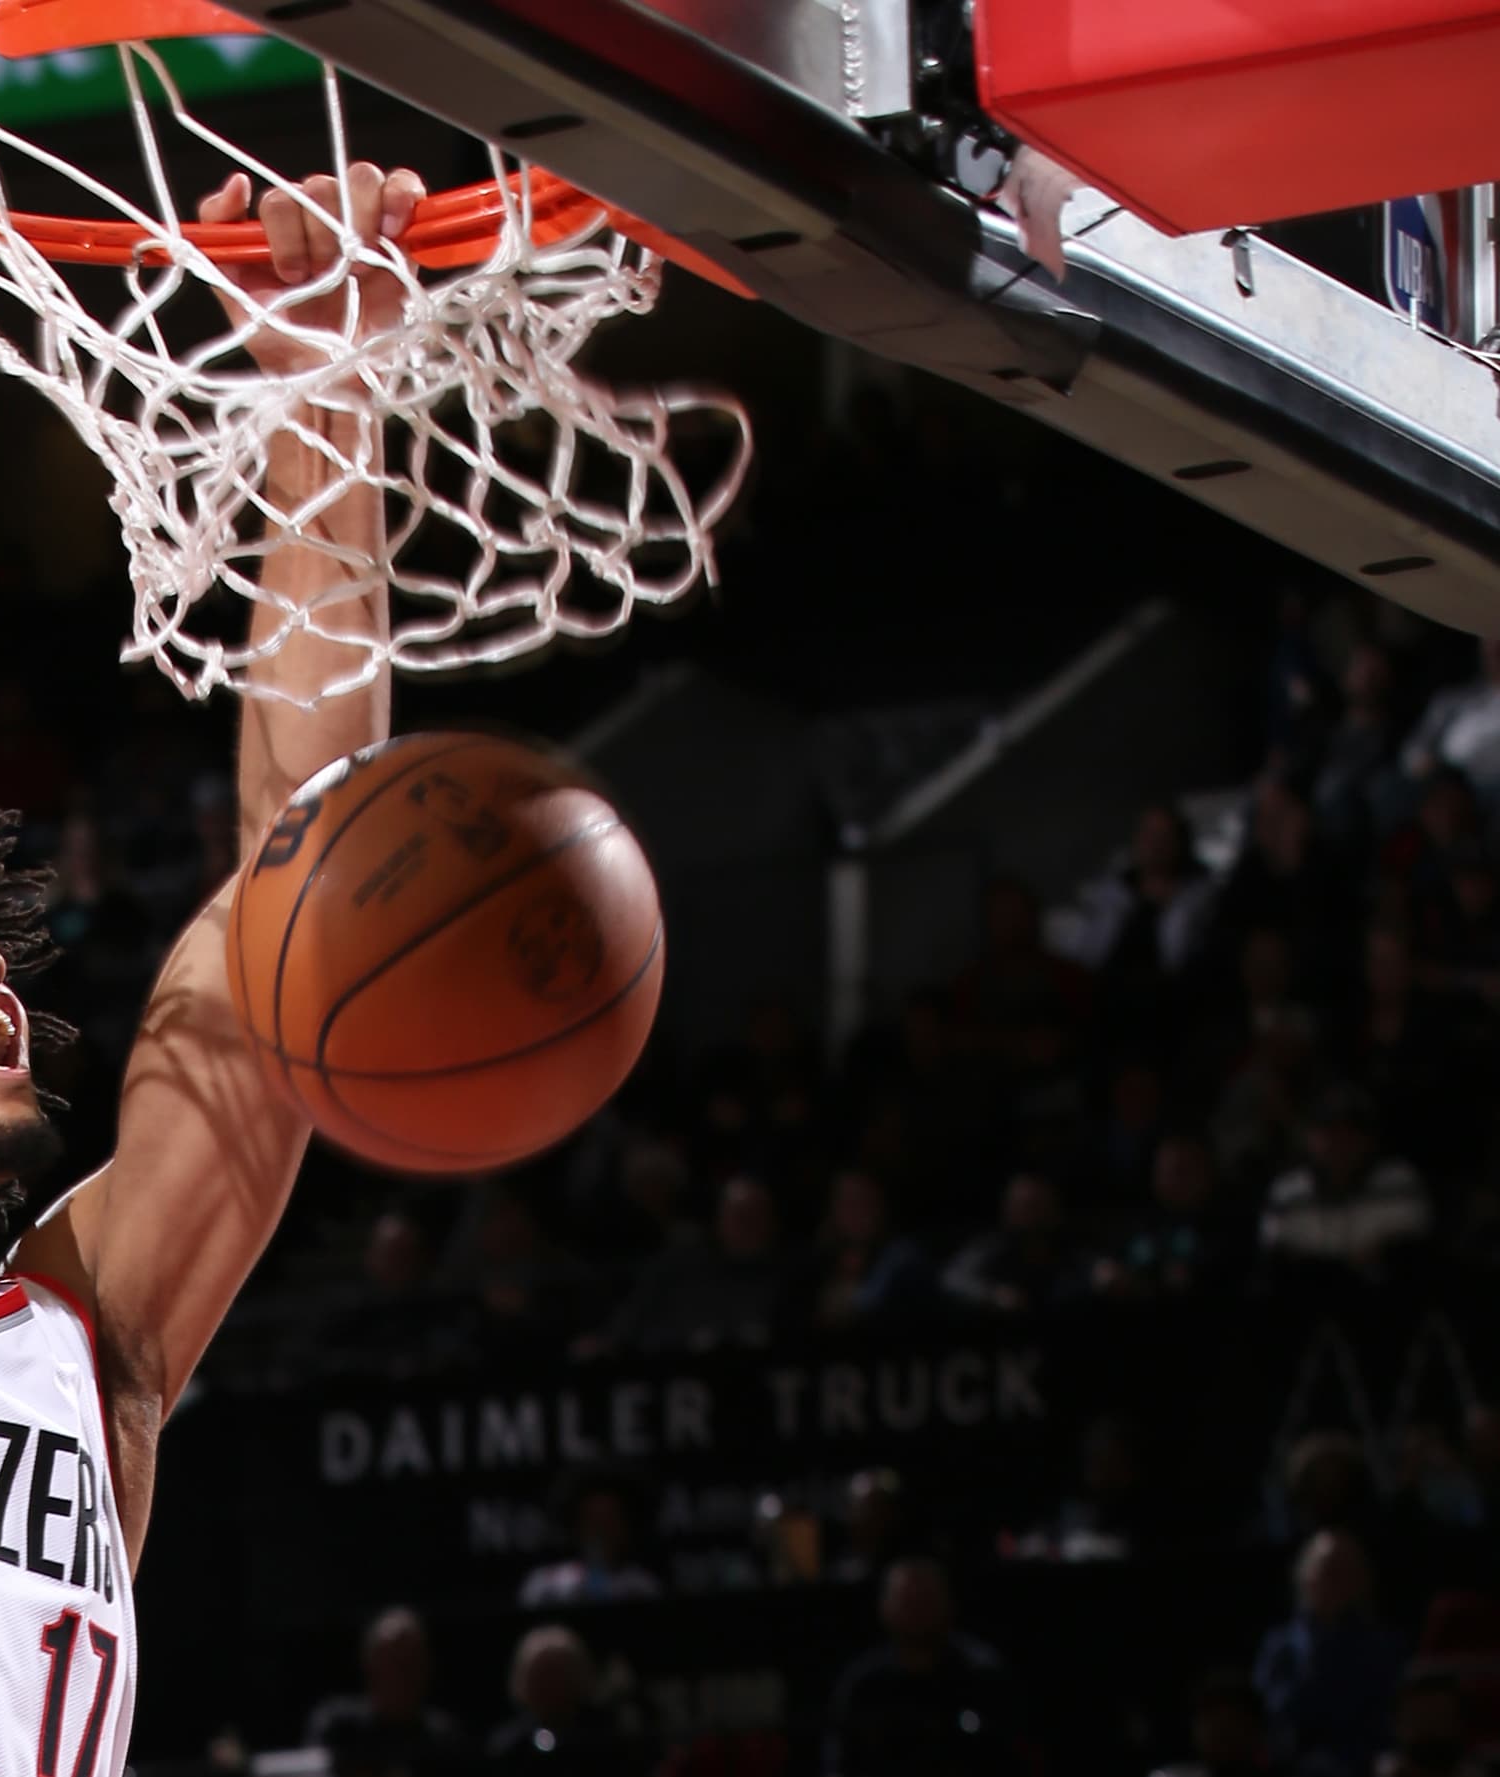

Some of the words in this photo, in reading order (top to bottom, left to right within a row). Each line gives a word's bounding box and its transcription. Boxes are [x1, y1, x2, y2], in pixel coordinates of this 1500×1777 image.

[1397, 230, 1435, 308] NBA
[318, 1378, 714, 1485] DAIMLER
[766, 1347, 1047, 1437] TRUCK
[37, 1607, 119, 1777] 17
